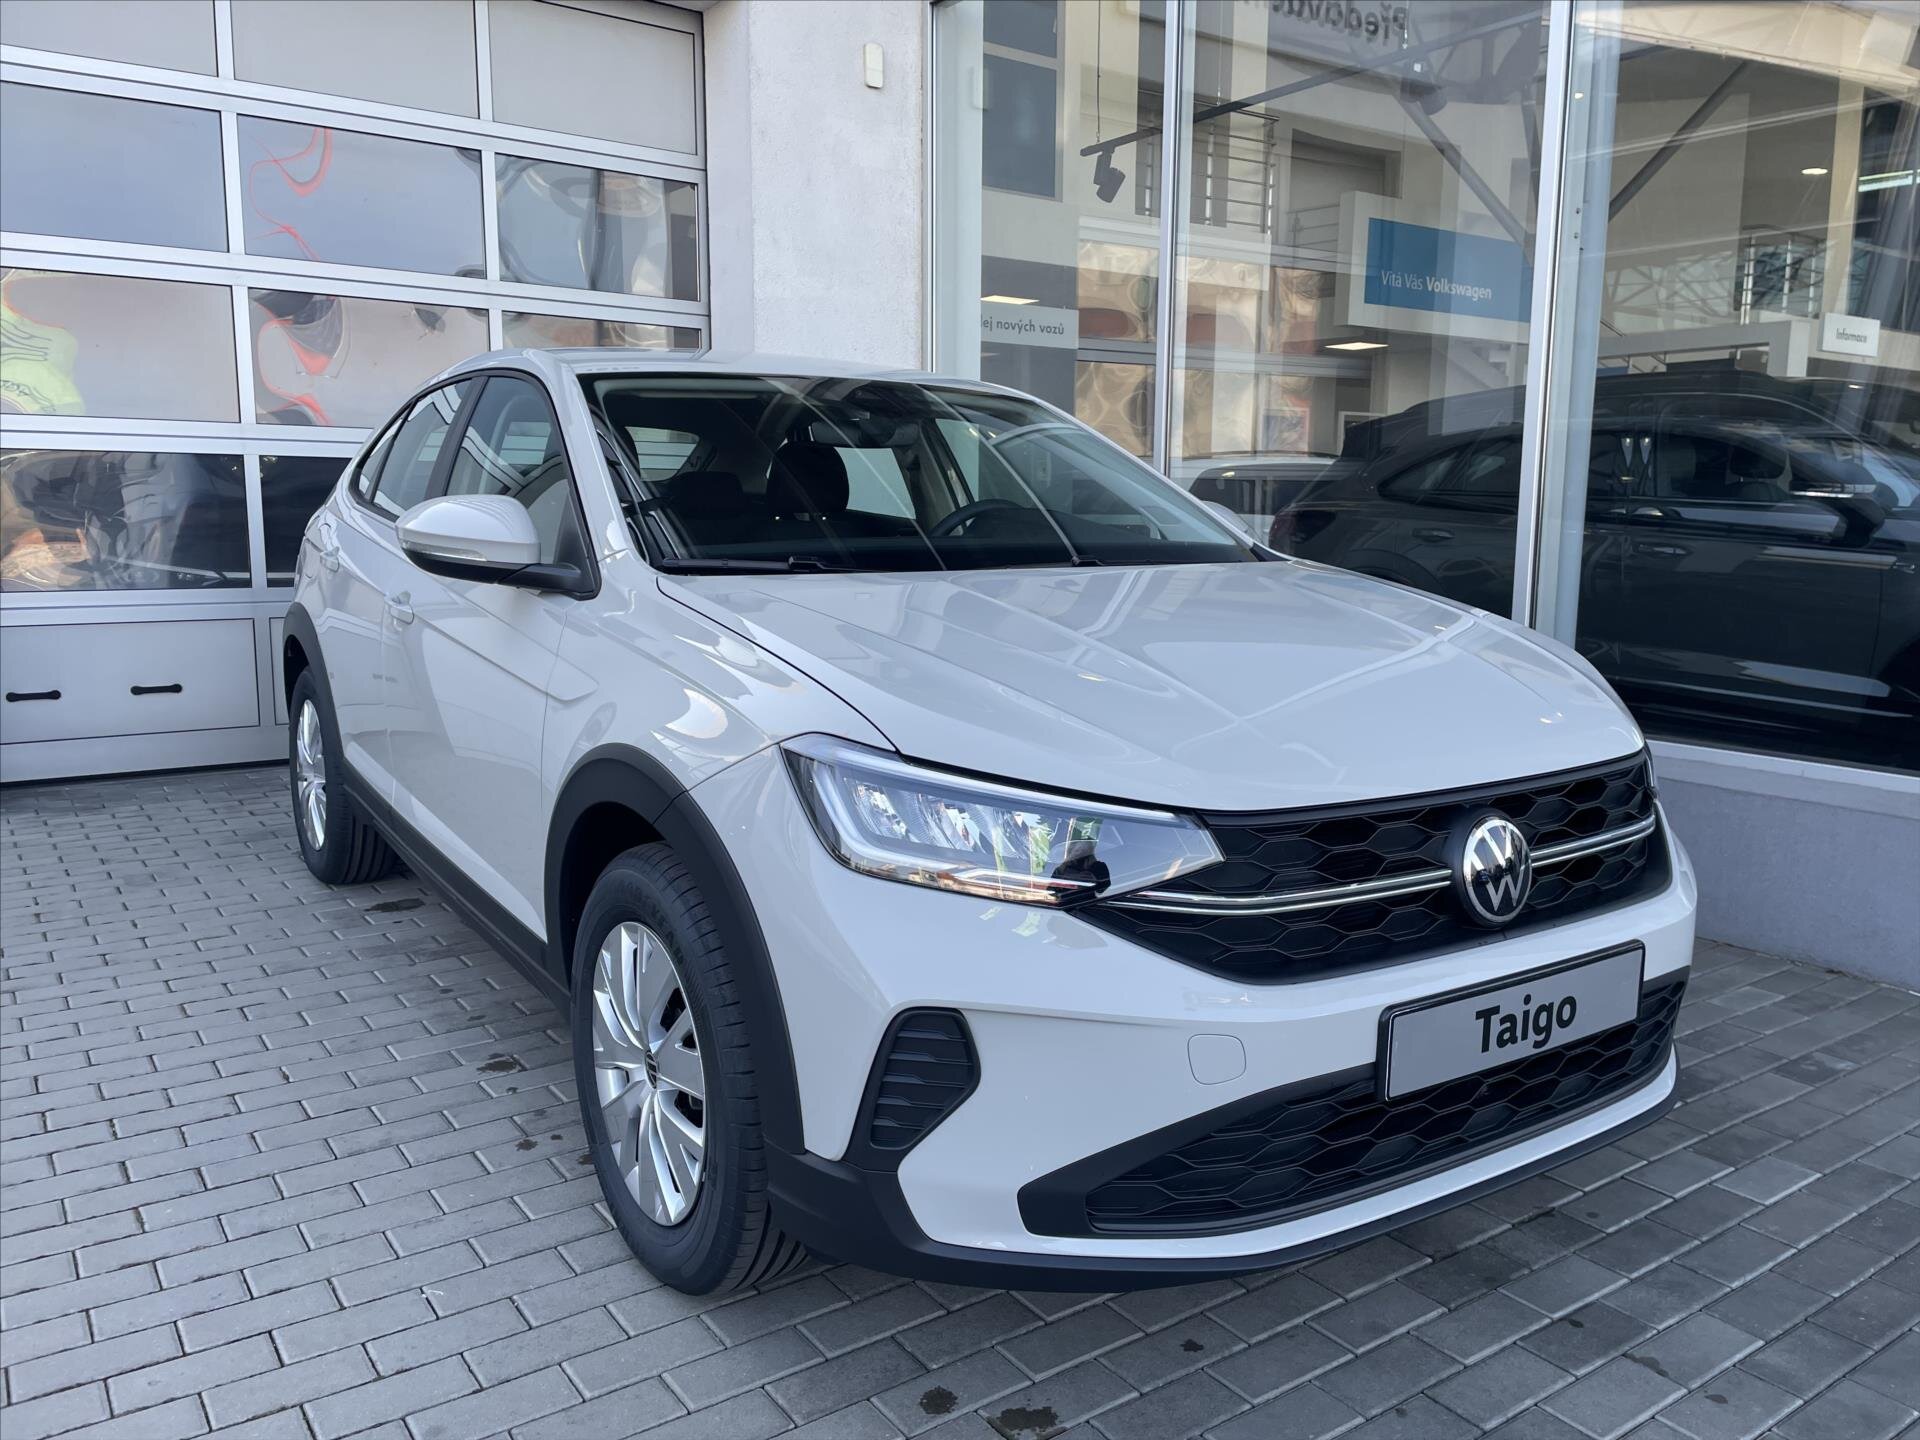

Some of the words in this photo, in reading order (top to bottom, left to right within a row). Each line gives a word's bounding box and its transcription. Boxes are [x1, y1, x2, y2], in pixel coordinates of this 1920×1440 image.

[1404, 273, 1424, 290] Vás
[1425, 276, 1493, 301] Volkswagen
[996, 318, 1036, 334] nových
[1038, 322, 1065, 335] vozů
[1475, 993, 1577, 1054] Taigo
